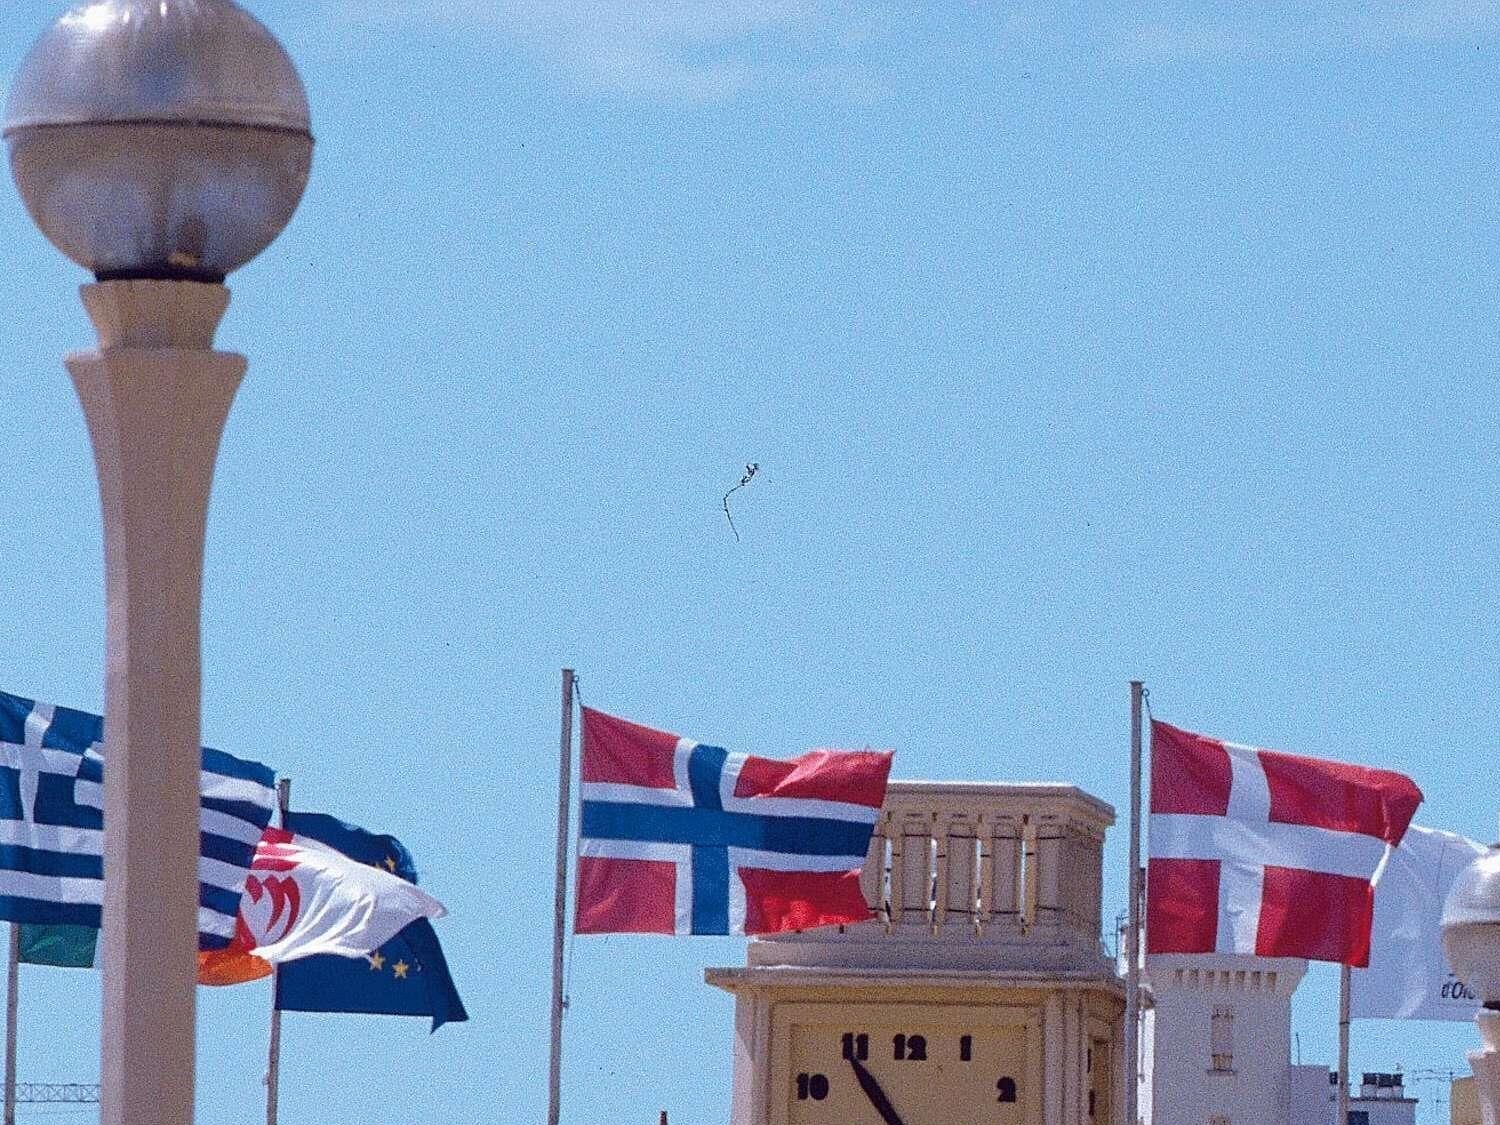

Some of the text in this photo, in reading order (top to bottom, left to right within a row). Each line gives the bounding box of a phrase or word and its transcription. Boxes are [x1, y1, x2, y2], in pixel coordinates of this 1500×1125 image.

[841, 1032, 869, 1061] 11
[892, 1033, 927, 1061] 12
[960, 1035, 972, 1061] 1
[796, 1072, 829, 1101] 10
[997, 1076, 1016, 1103] 2
